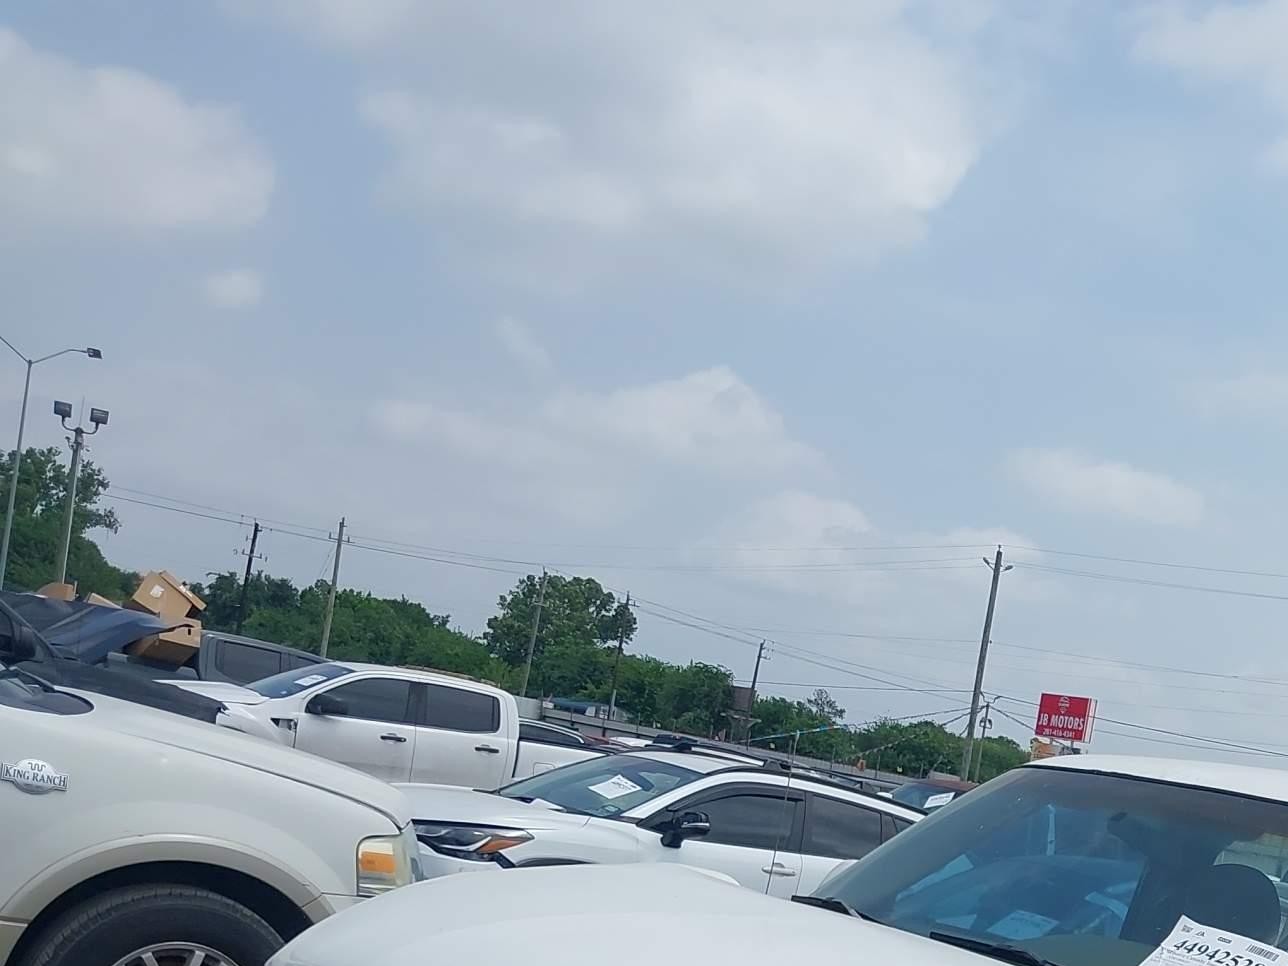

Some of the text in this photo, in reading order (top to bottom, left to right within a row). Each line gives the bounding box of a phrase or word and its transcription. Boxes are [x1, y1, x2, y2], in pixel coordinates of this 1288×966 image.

[1038, 713, 1085, 730] JB MOTORS
[5, 766, 67, 787] KING RANCH
